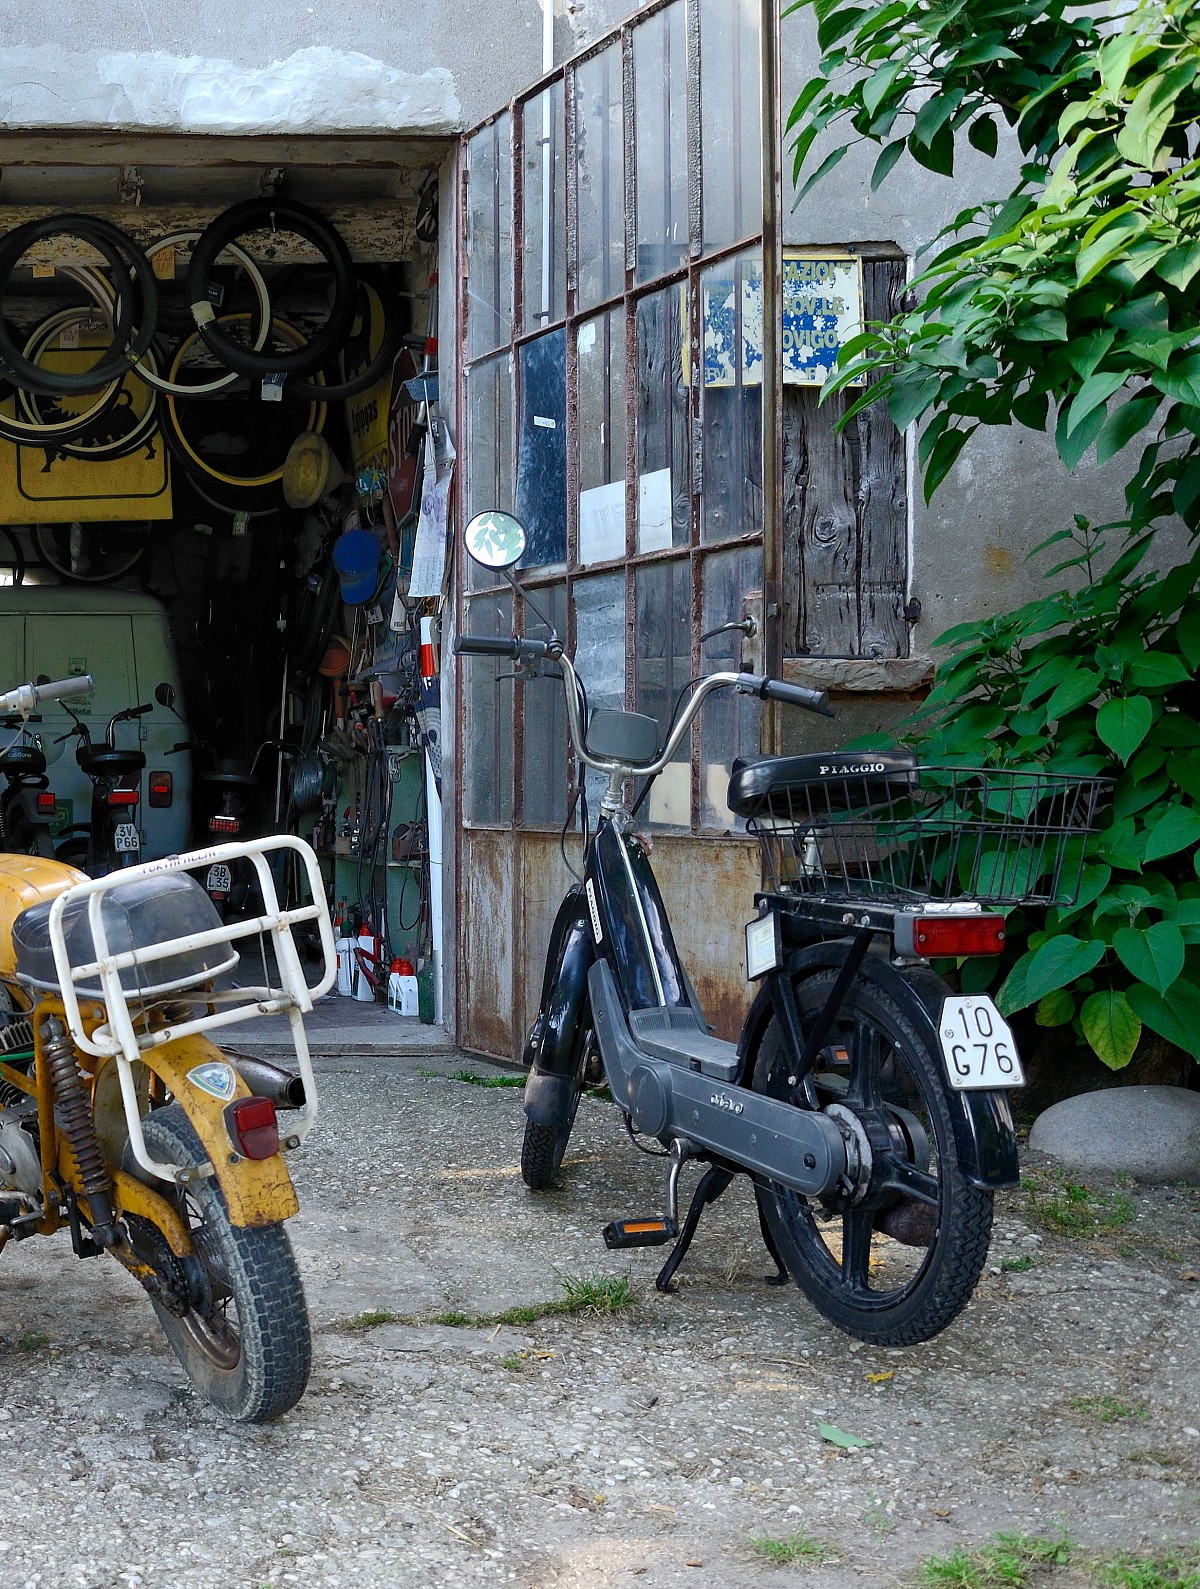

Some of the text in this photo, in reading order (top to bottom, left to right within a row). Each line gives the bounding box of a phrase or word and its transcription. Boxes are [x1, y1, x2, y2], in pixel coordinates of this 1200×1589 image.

[819, 762, 885, 775] PIAGGIO
[119, 826, 132, 837] 3V
[116, 836, 138, 849] P66
[213, 865, 227, 878] 3B
[208, 876, 229, 889] L35
[957, 1006, 994, 1039] 10
[951, 1042, 1014, 1077] G76
